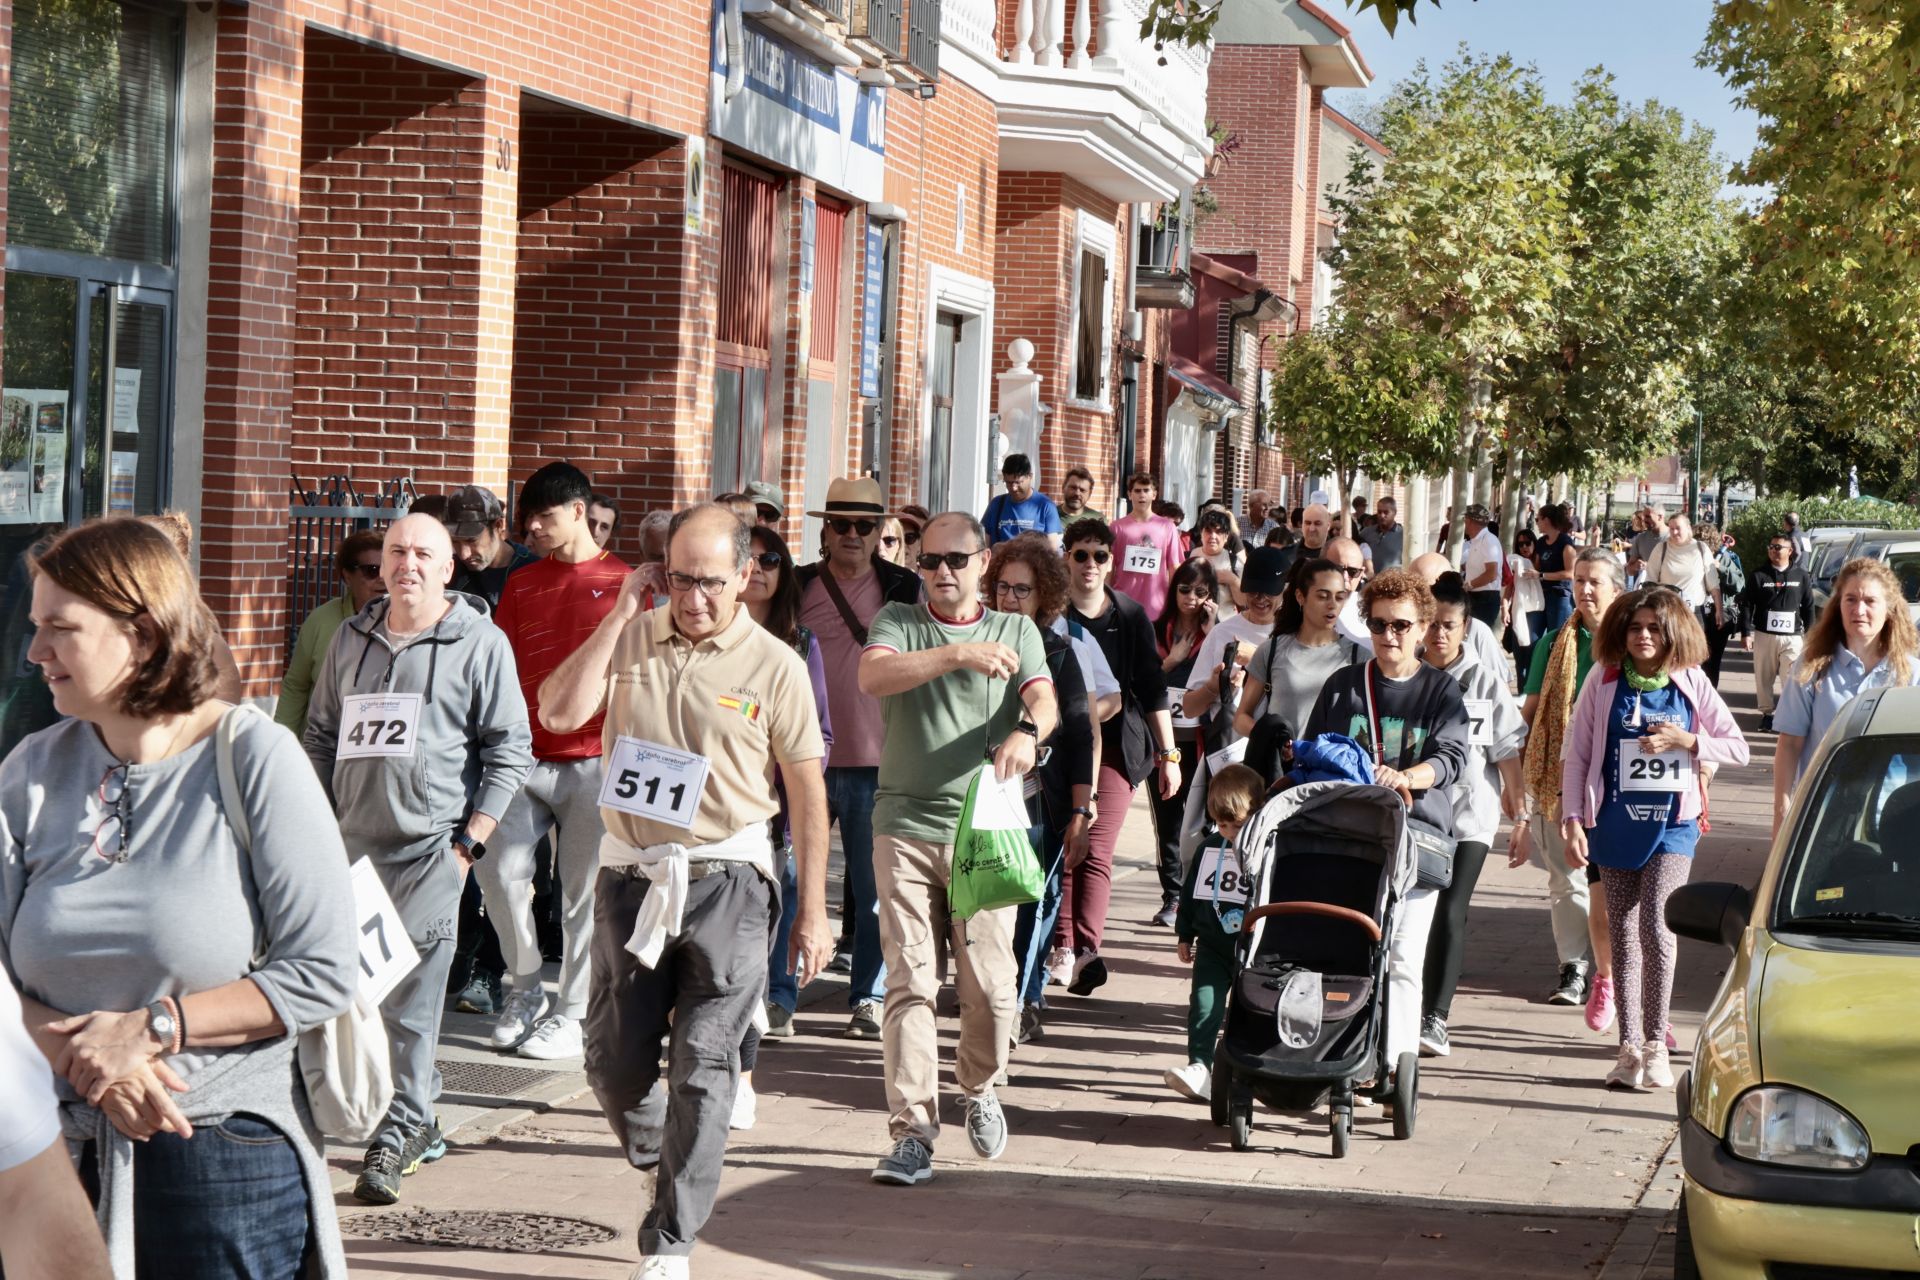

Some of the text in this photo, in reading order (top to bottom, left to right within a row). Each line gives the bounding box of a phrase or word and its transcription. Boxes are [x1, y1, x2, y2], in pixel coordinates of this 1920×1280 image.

[744, 27, 785, 93] TALLERES
[496, 137, 511, 171] 30
[1130, 555, 1156, 569] 175
[1771, 618, 1791, 628] 073
[1171, 702, 1183, 719] 2
[1646, 714, 1681, 723] BANCO DE
[347, 719, 407, 746] 472
[1470, 717, 1485, 736] 7
[1629, 758, 1680, 780] 291
[614, 768, 686, 812] 511
[1204, 869, 1254, 896] 489
[426, 929, 454, 941] MAX
